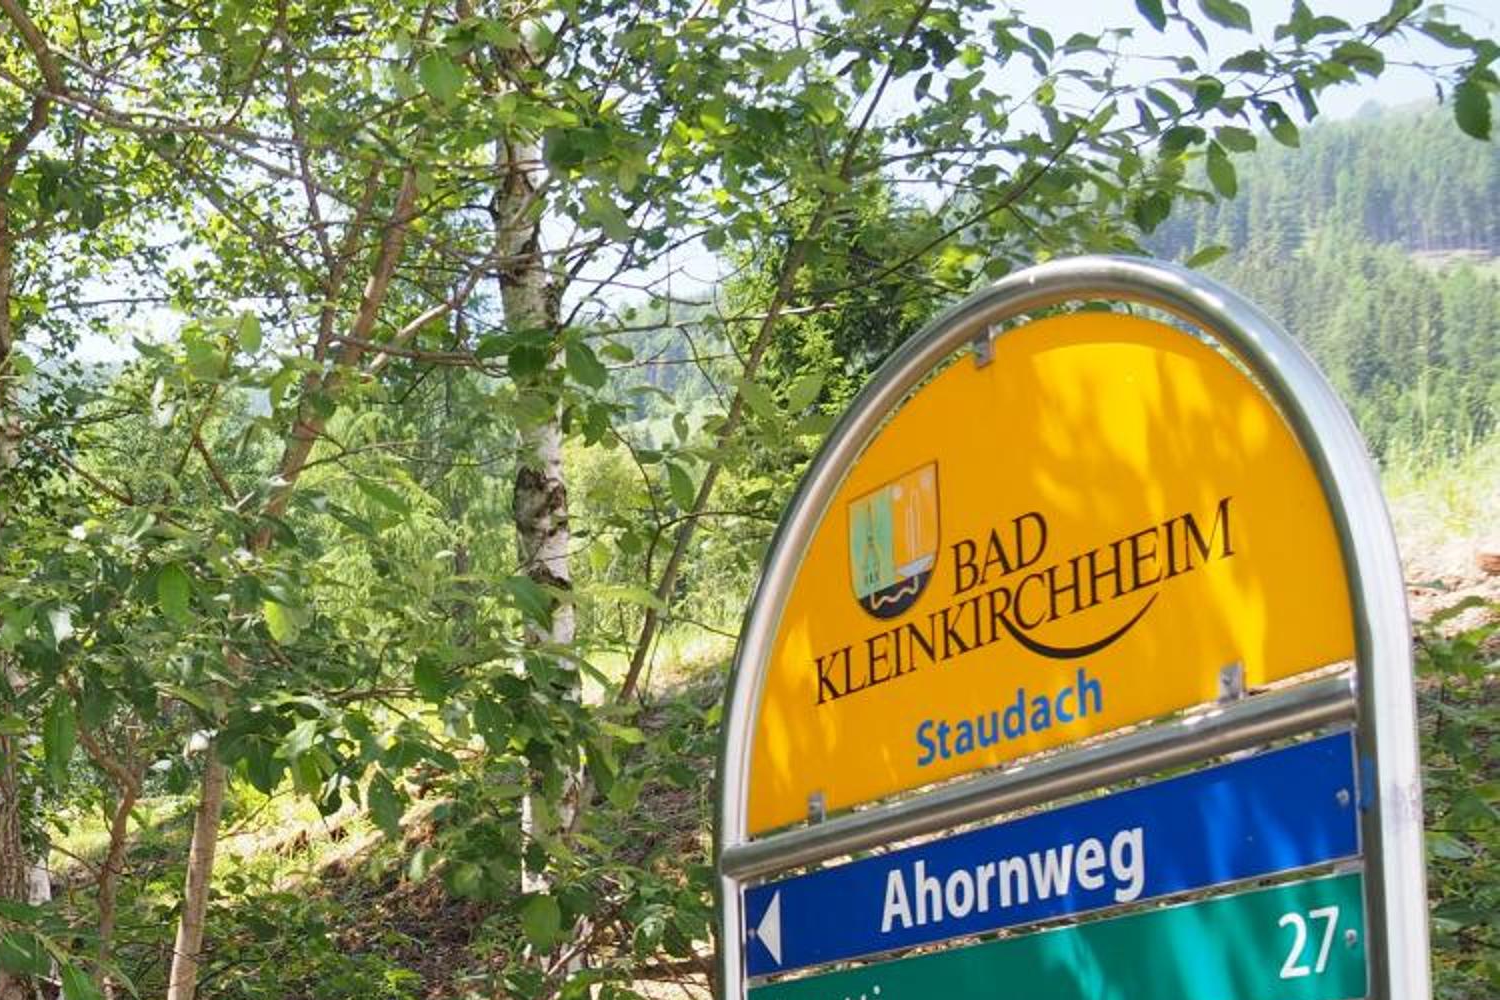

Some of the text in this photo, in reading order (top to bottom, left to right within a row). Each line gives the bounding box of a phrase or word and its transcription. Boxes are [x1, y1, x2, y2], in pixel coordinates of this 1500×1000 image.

[814, 497, 1236, 704] KLEINKIRCHHEIM
[950, 512, 1048, 595] BAD
[915, 669, 1103, 766] Staudach
[881, 824, 1145, 933] Ahornweg
[1278, 906, 1340, 980] 27
